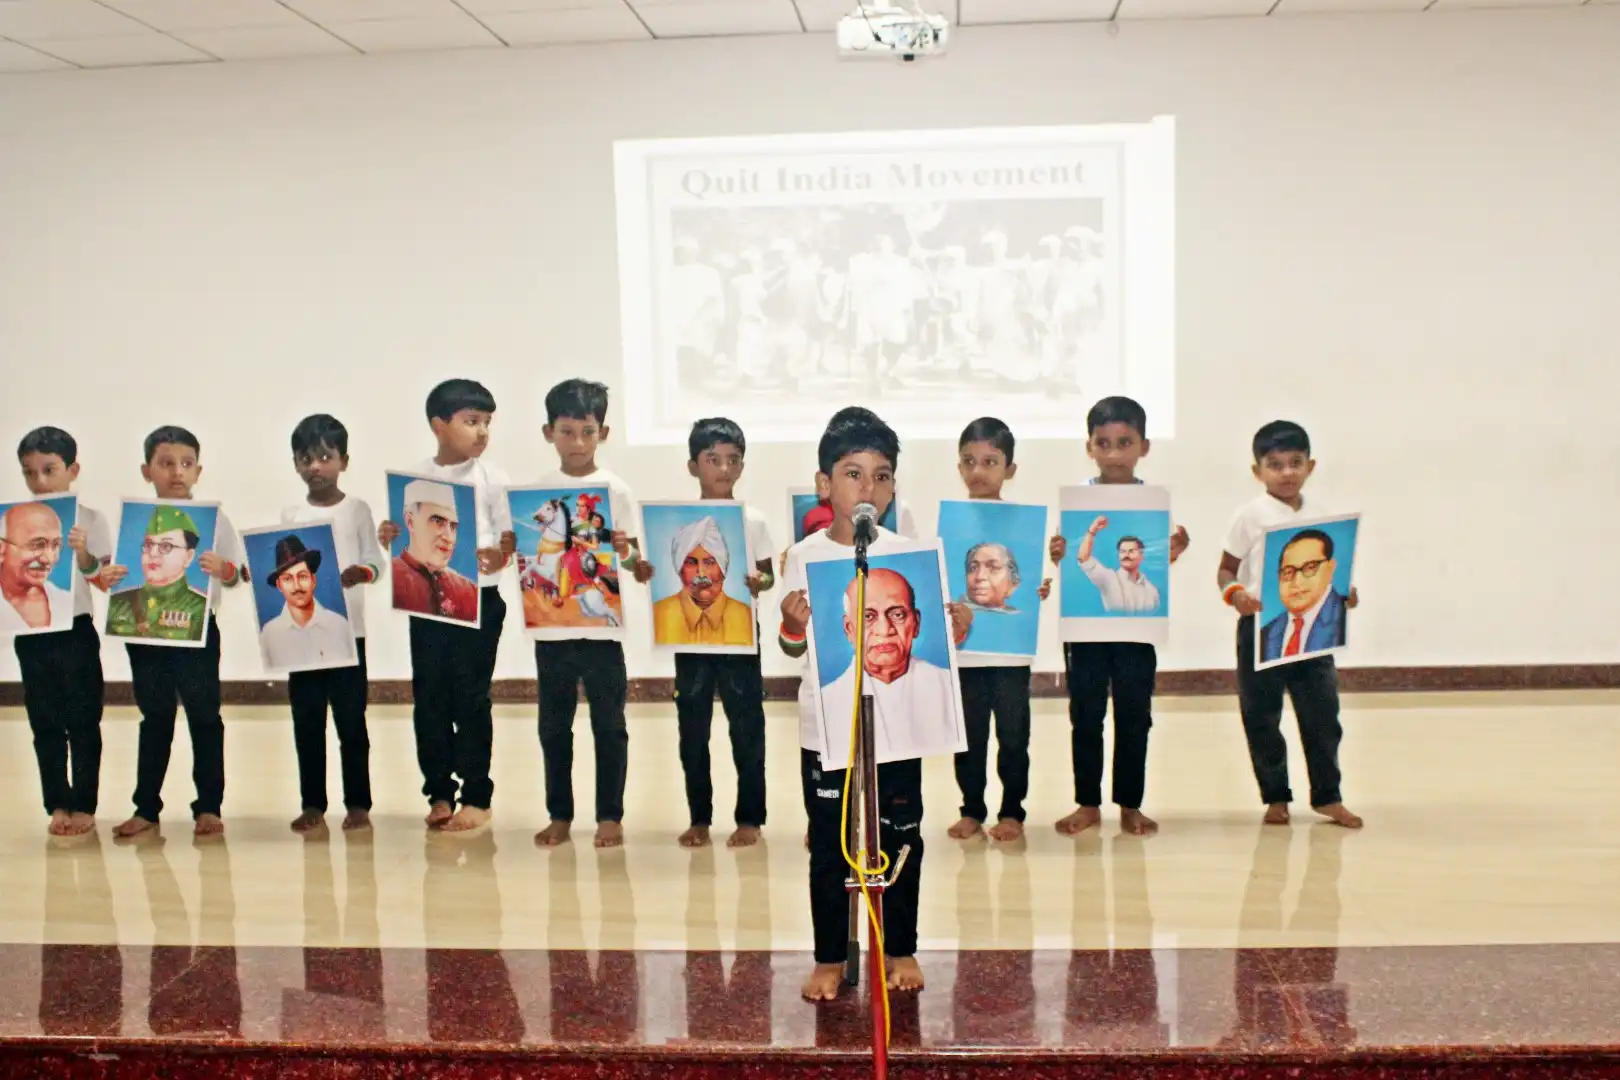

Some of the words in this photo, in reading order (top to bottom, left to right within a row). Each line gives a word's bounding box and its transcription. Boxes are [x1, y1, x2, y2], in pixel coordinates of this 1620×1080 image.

[680, 168, 761, 199] Quit
[777, 166, 872, 193] India
[888, 161, 1086, 190] Movement
